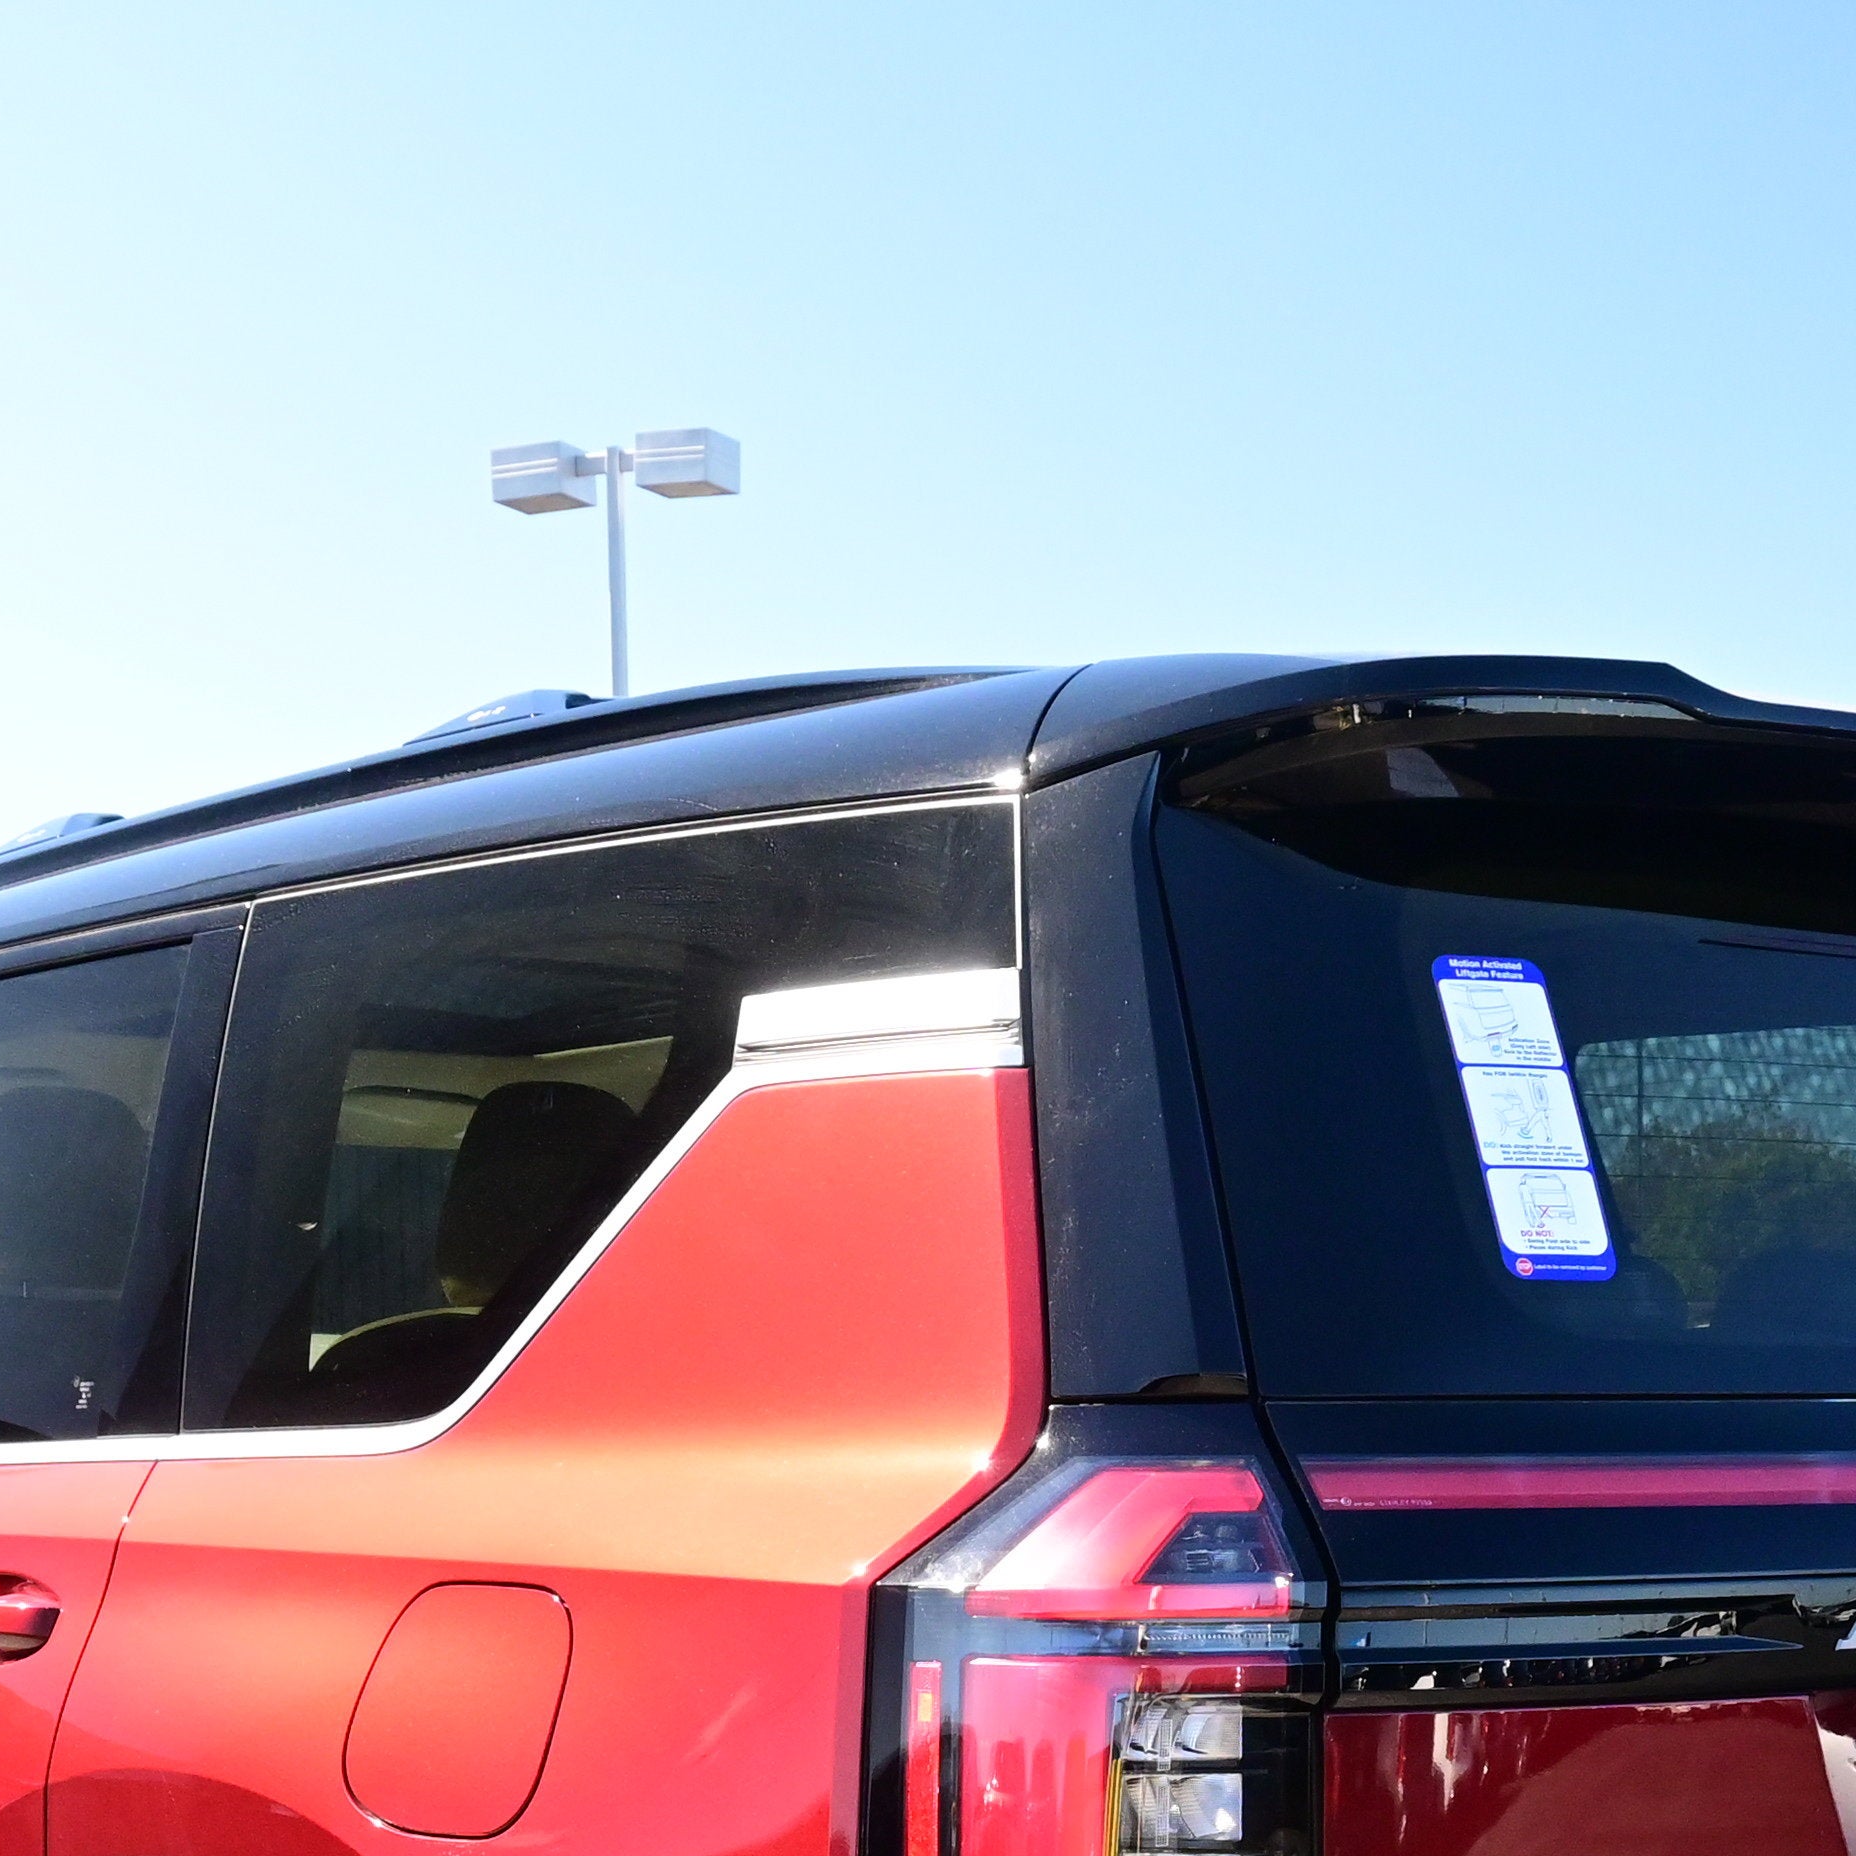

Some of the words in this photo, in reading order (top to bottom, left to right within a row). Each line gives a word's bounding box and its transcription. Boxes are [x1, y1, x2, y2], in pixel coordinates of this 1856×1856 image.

[1448, 958, 1480, 968] Motion
[1482, 959, 1522, 970] Activated
[1455, 968, 1489, 979] Liftgate
[1490, 970, 1524, 980] Feature
